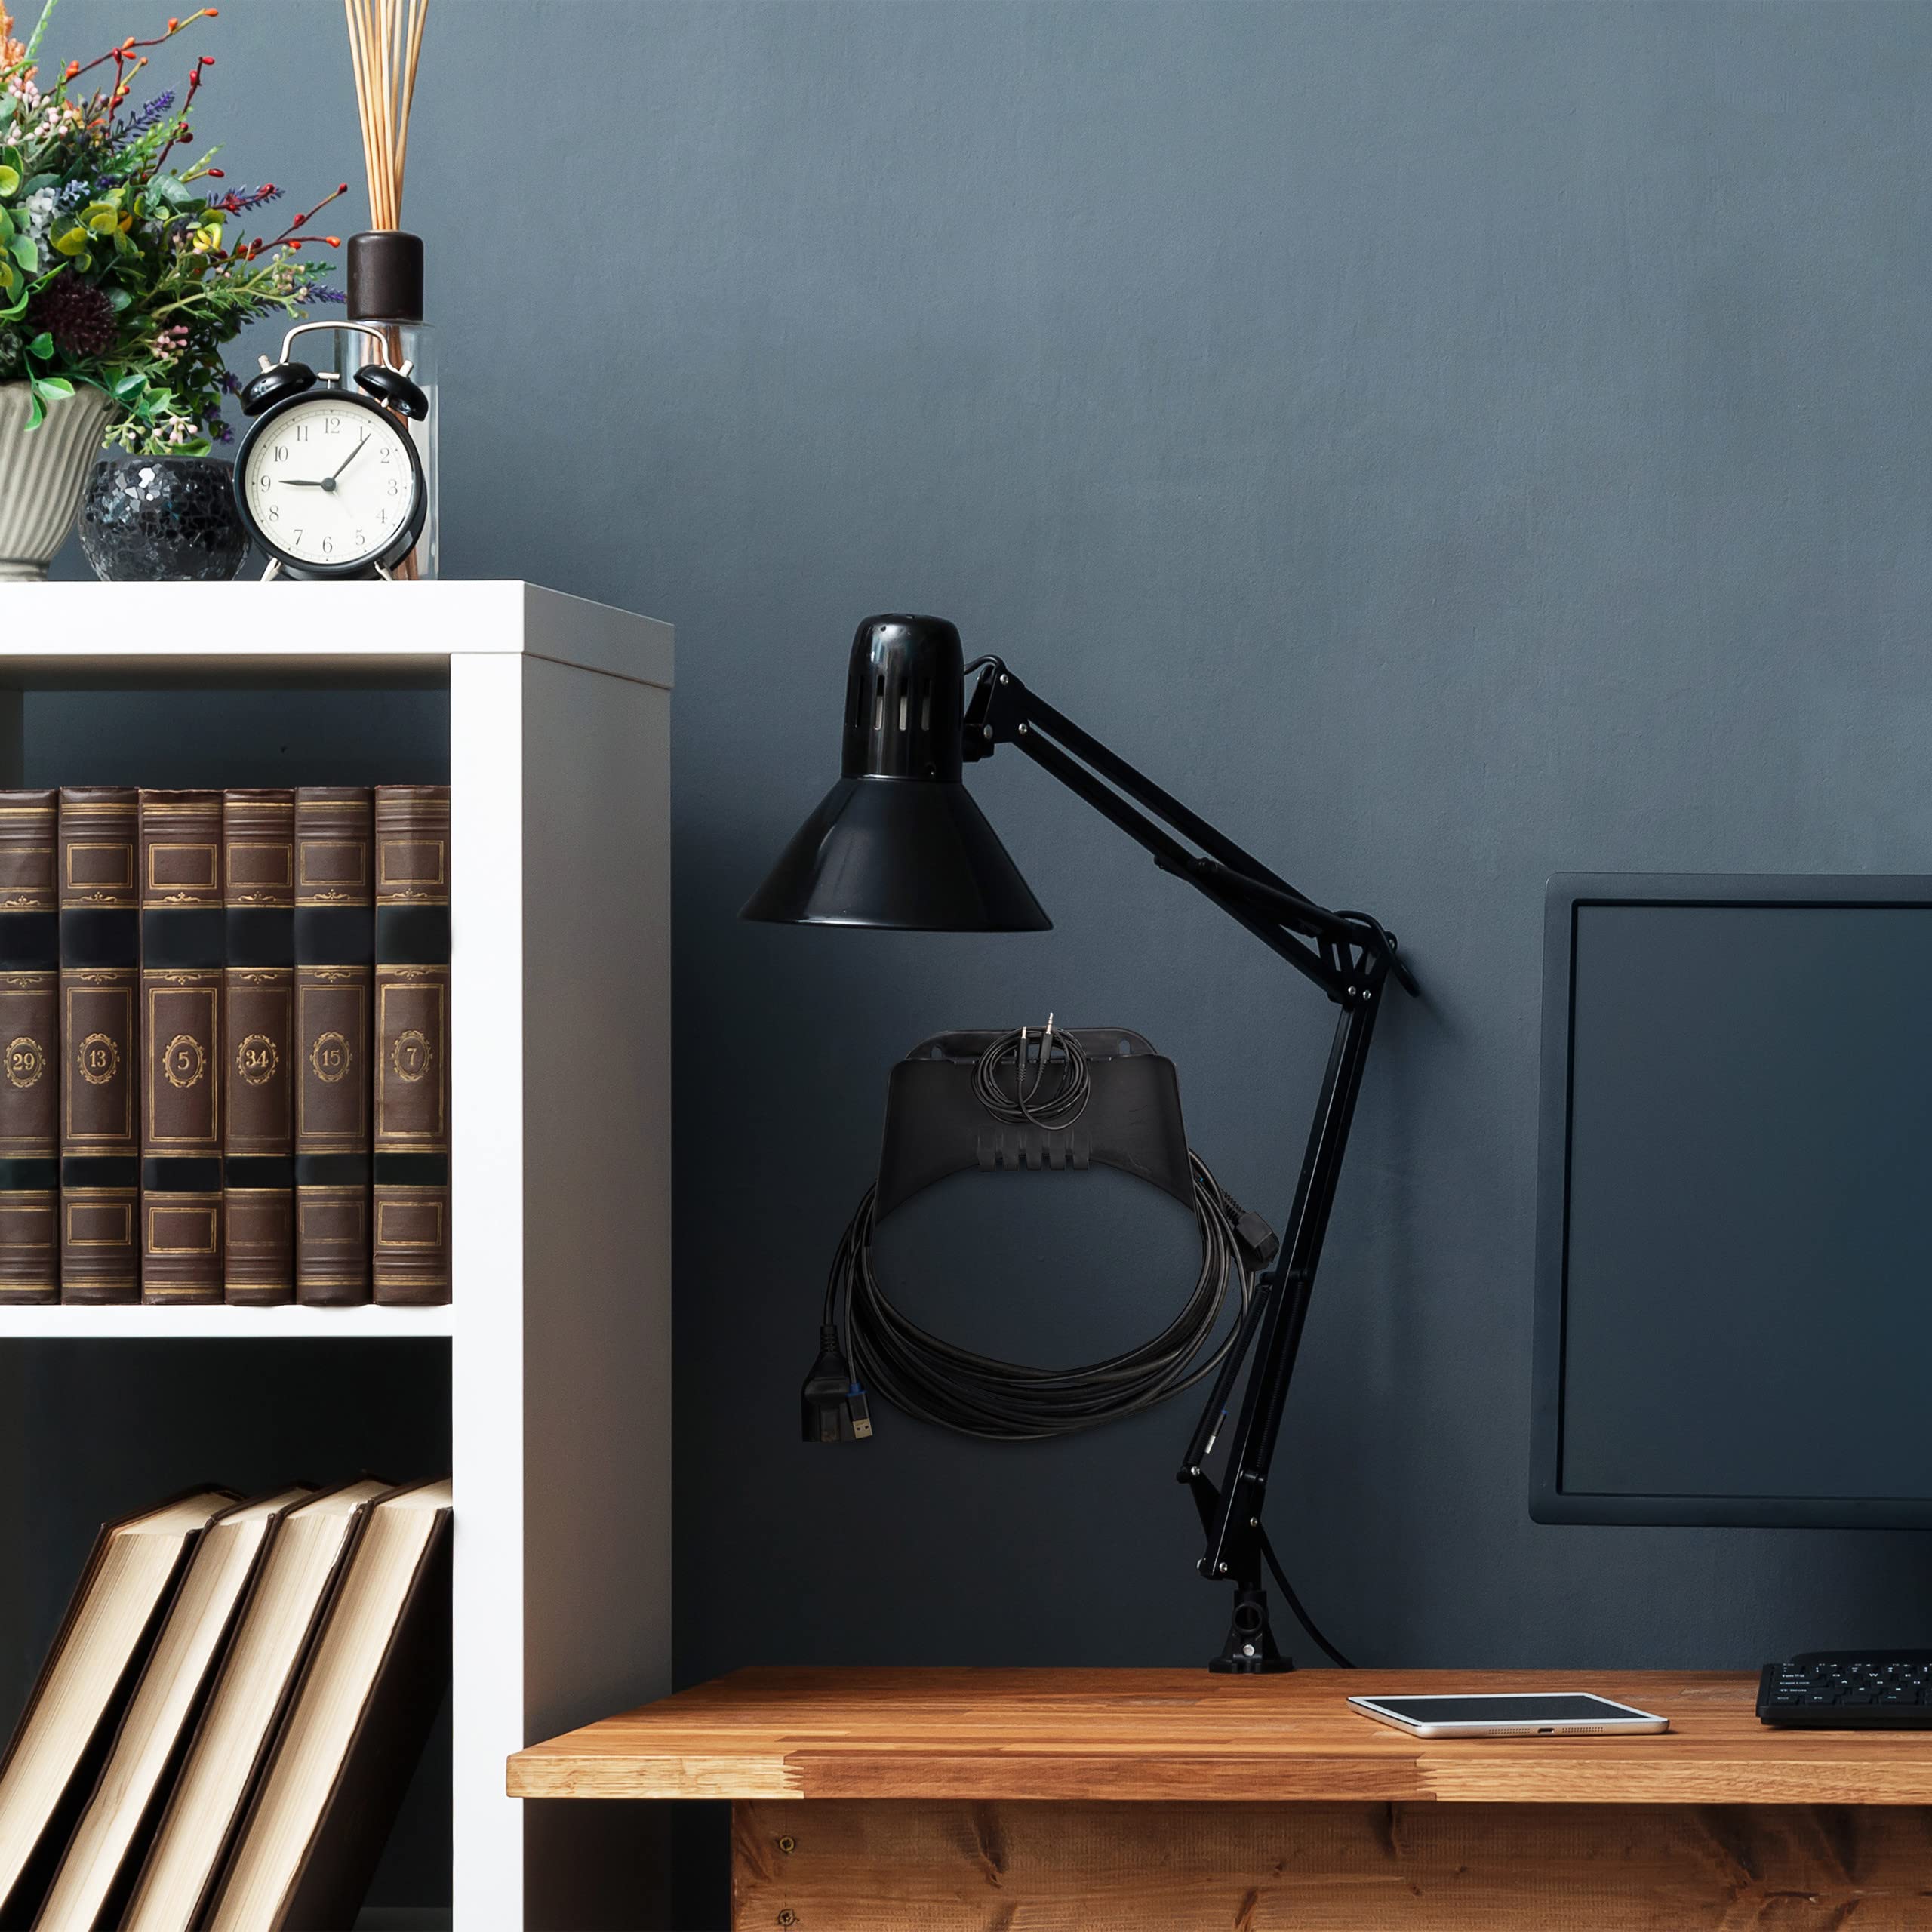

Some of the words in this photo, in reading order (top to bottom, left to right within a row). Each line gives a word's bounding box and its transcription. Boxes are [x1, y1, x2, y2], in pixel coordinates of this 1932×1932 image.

[296, 425, 309, 441] 11
[325, 417, 340, 433] 12
[359, 426, 365, 441] 1
[274, 446, 288, 462] 10
[380, 448, 390, 464] 2
[260, 475, 271, 492] 9
[387, 479, 398, 496] 3
[269, 506, 279, 521] 8
[376, 508, 387, 524] 4
[294, 529, 303, 546] 7
[322, 537, 333, 553] 6
[355, 530, 365, 546] 5
[12, 1053, 35, 1071] 29
[89, 1050, 106, 1067] 13
[177, 1051, 189, 1070] 5
[245, 1049, 269, 1067] 34
[321, 1049, 340, 1067] 15
[406, 1047, 417, 1066] 7
